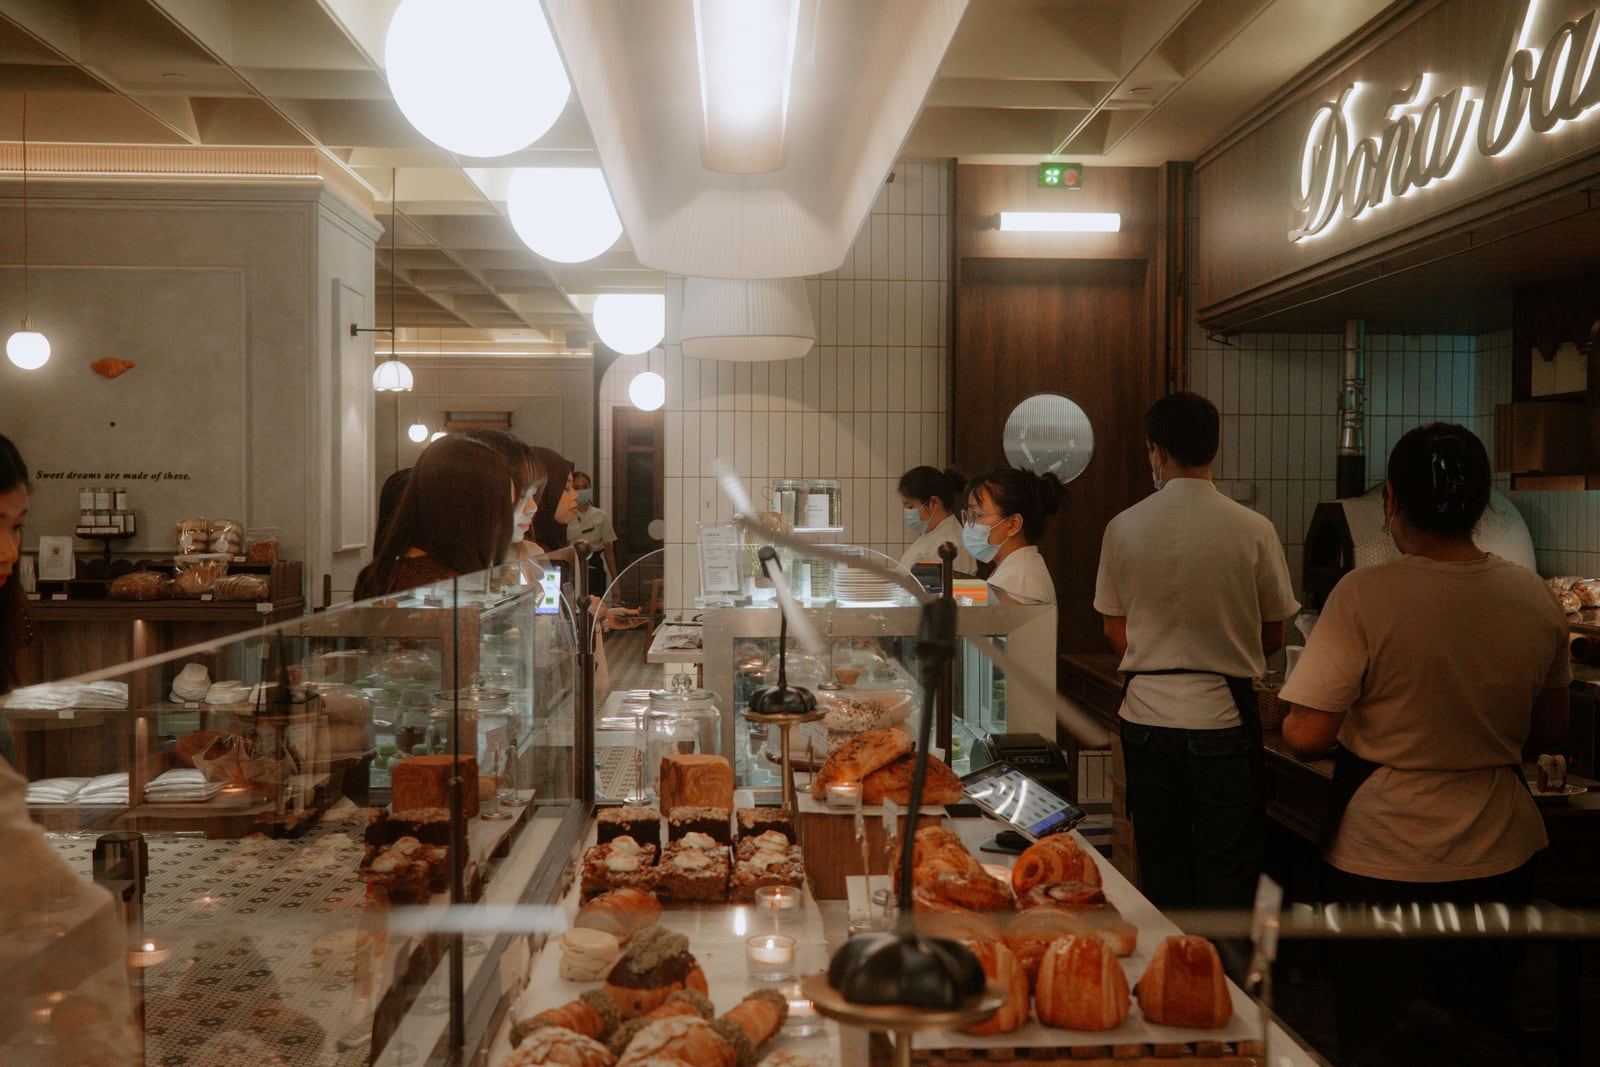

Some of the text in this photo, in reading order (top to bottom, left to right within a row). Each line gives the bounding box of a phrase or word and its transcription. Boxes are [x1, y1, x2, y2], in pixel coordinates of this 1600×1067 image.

[35, 470, 191, 482] Sweet dreams are made of these.
